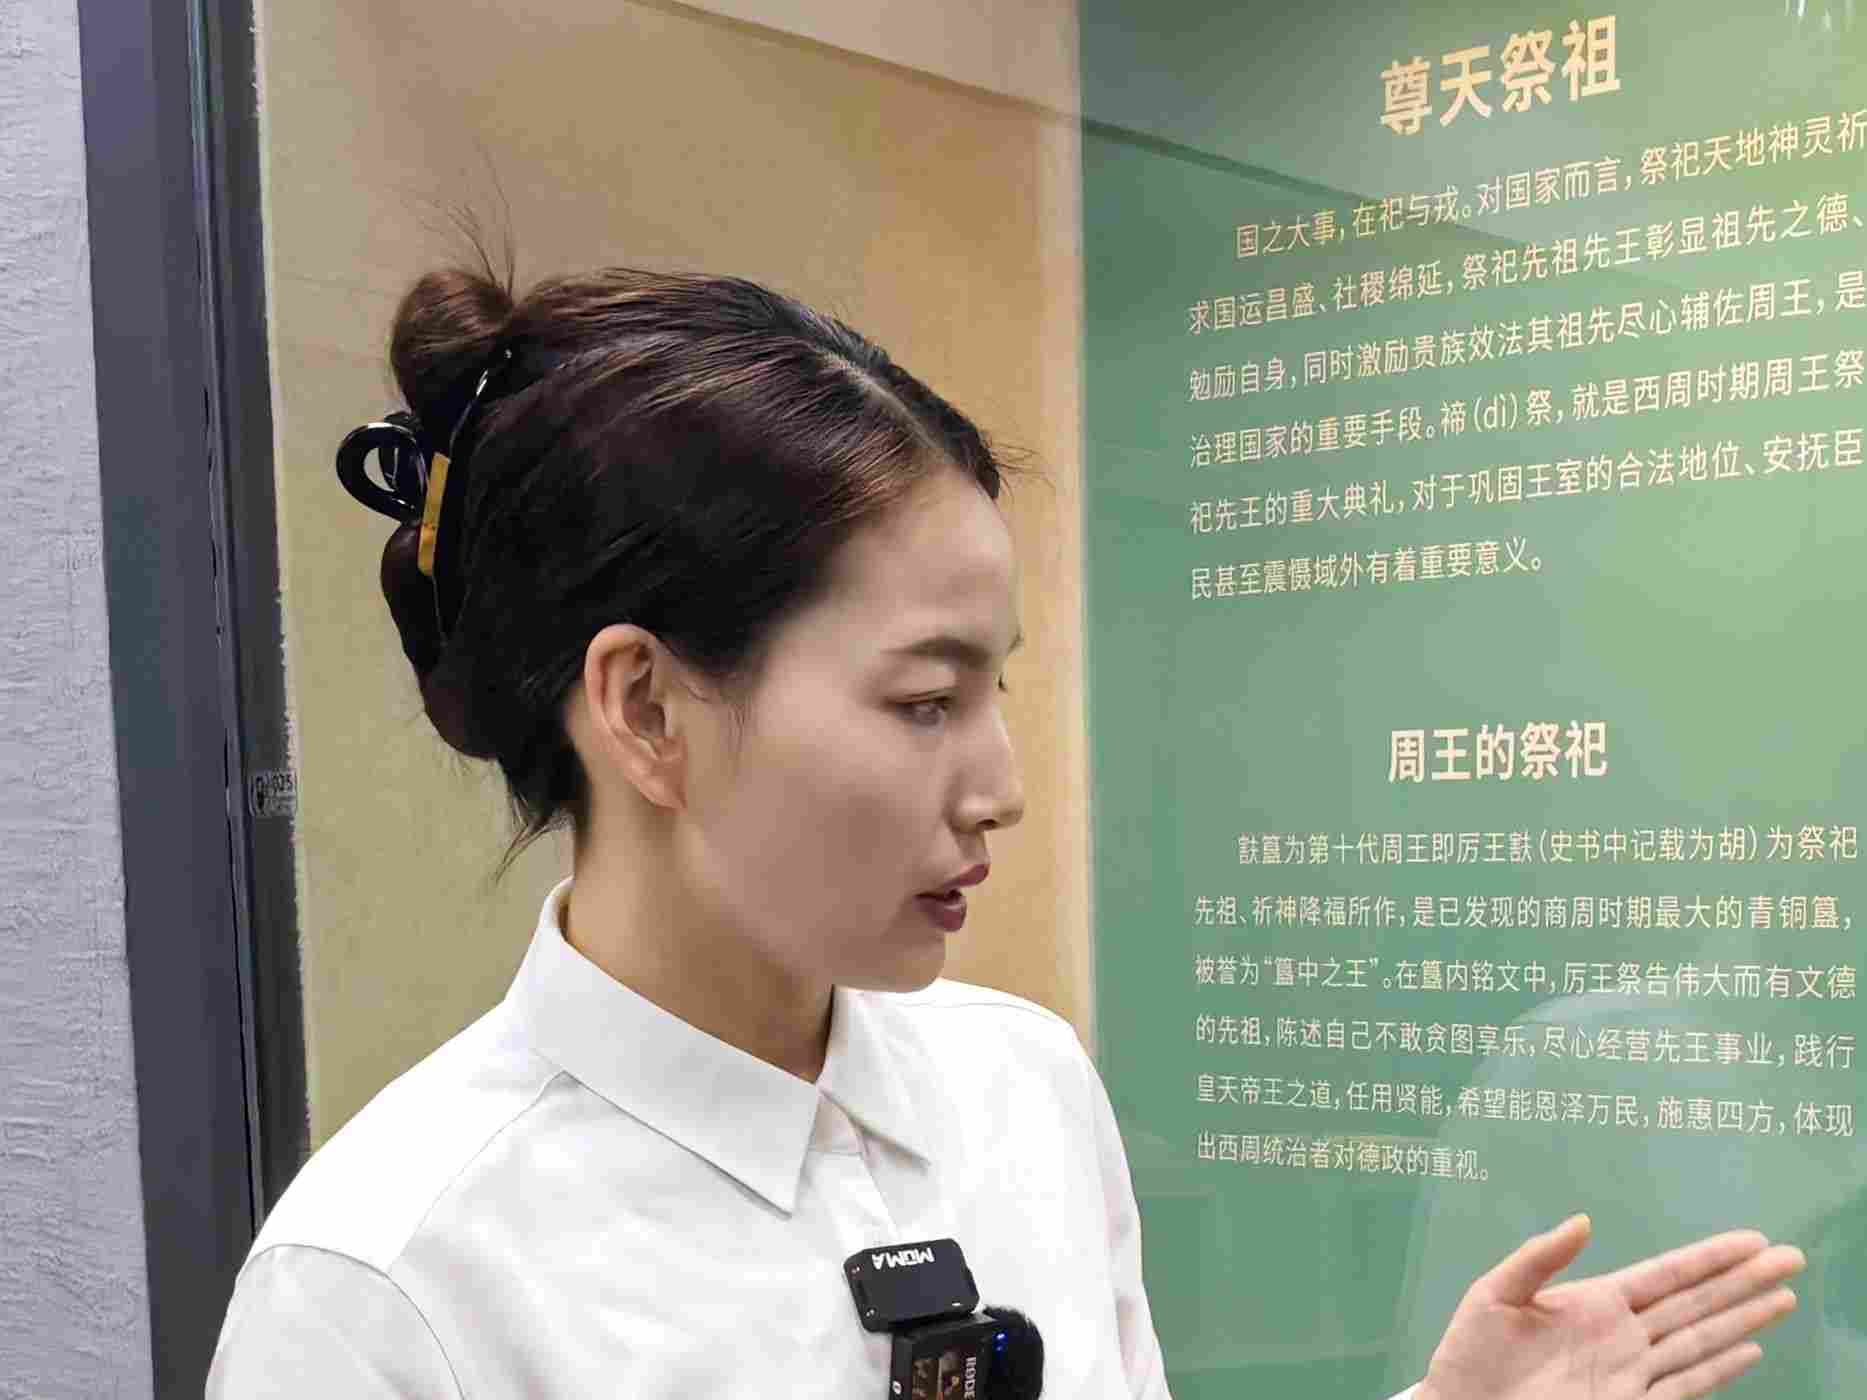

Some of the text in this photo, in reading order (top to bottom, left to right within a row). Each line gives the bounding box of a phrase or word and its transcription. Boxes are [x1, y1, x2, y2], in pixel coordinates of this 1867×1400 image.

[1380, 16, 1622, 136] 尊天祭祖
[1388, 720, 1609, 783] 周王的祭祀
